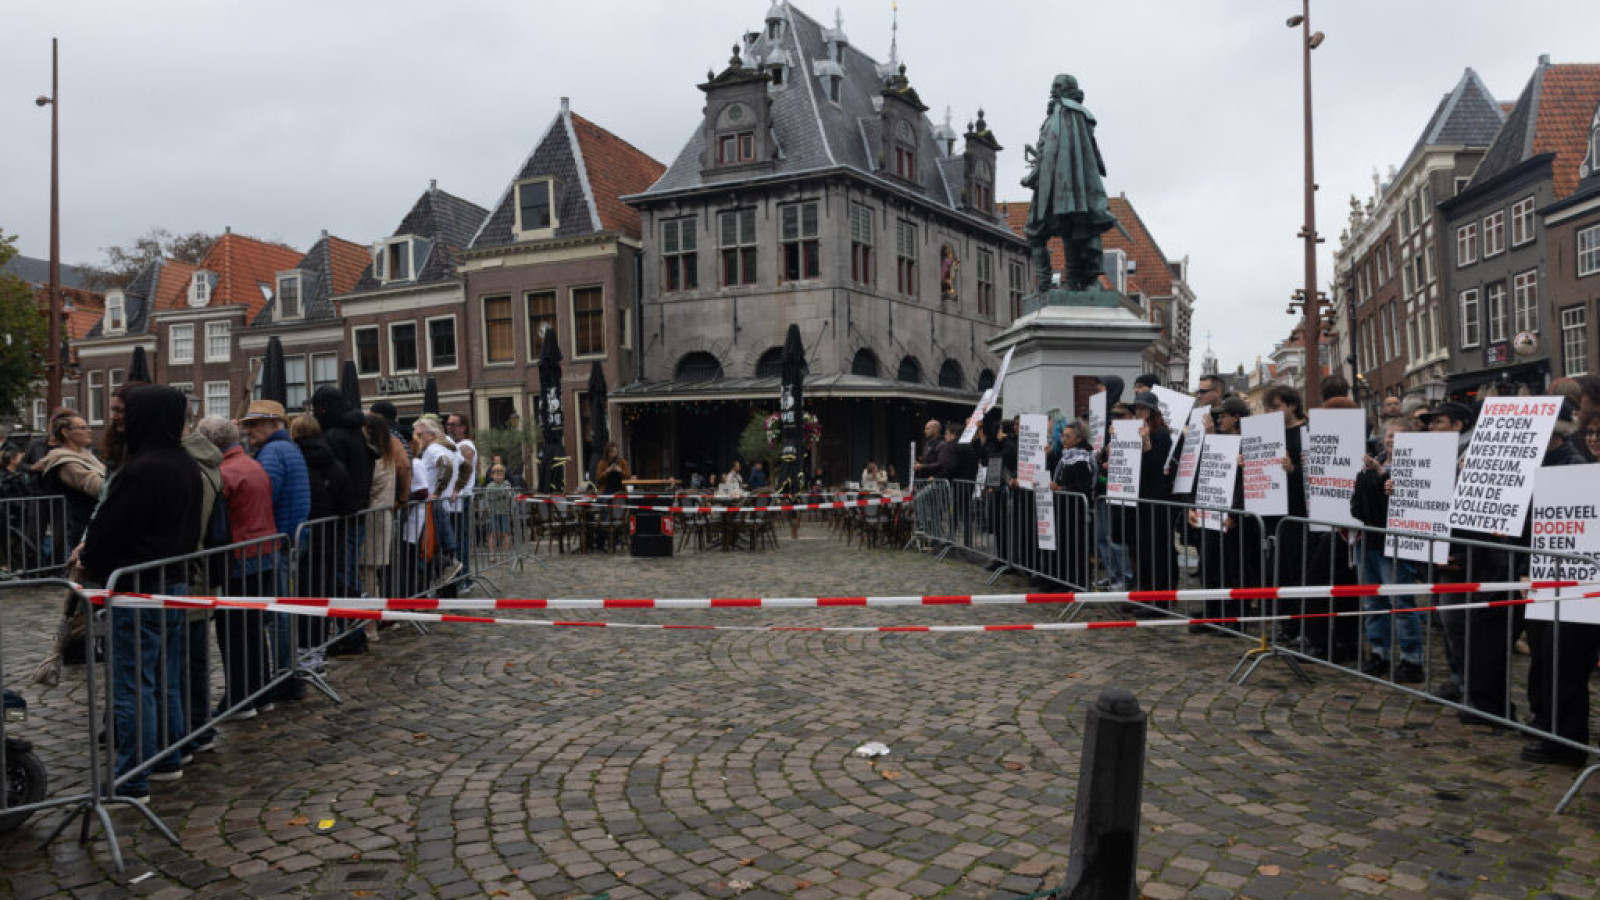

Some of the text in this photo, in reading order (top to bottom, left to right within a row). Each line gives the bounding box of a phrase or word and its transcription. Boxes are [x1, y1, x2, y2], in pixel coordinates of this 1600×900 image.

[1484, 404, 1557, 416] VERPLAATS
[1478, 417, 1533, 430] JP COEN
[1311, 435, 1339, 444] HOORN
[1473, 431, 1538, 444] NAAR HET
[1311, 446, 1338, 455] HOUDT
[1394, 448, 1413, 457] WAT
[1470, 444, 1538, 459] WESTFRIES
[1311, 456, 1351, 467] VAST AAN
[1392, 458, 1431, 468] LEREN WE
[1465, 458, 1522, 473] MUSEUM,
[1311, 466, 1325, 475] EEN
[1391, 468, 1413, 478] ONZE
[1461, 471, 1526, 488] VOORZIEN
[1311, 487, 1351, 499] STANDBEE
[1407, 490, 1419, 499] WE
[1458, 485, 1503, 500] VAN DE
[1389, 499, 1451, 511] NORMALISEREN
[1453, 498, 1520, 517] VOLLEDIGE
[1388, 509, 1405, 518] DAT
[1534, 505, 1598, 519] HOEVEEL
[1388, 519, 1448, 533] SCHURKEN EEN
[1449, 512, 1510, 532] CONTEXT.
[1534, 521, 1585, 534] DODEN
[1386, 539, 1424, 551] KRJGEN?
[1534, 536, 1576, 549] IS EEN
[1532, 566, 1597, 580] WAARD?
